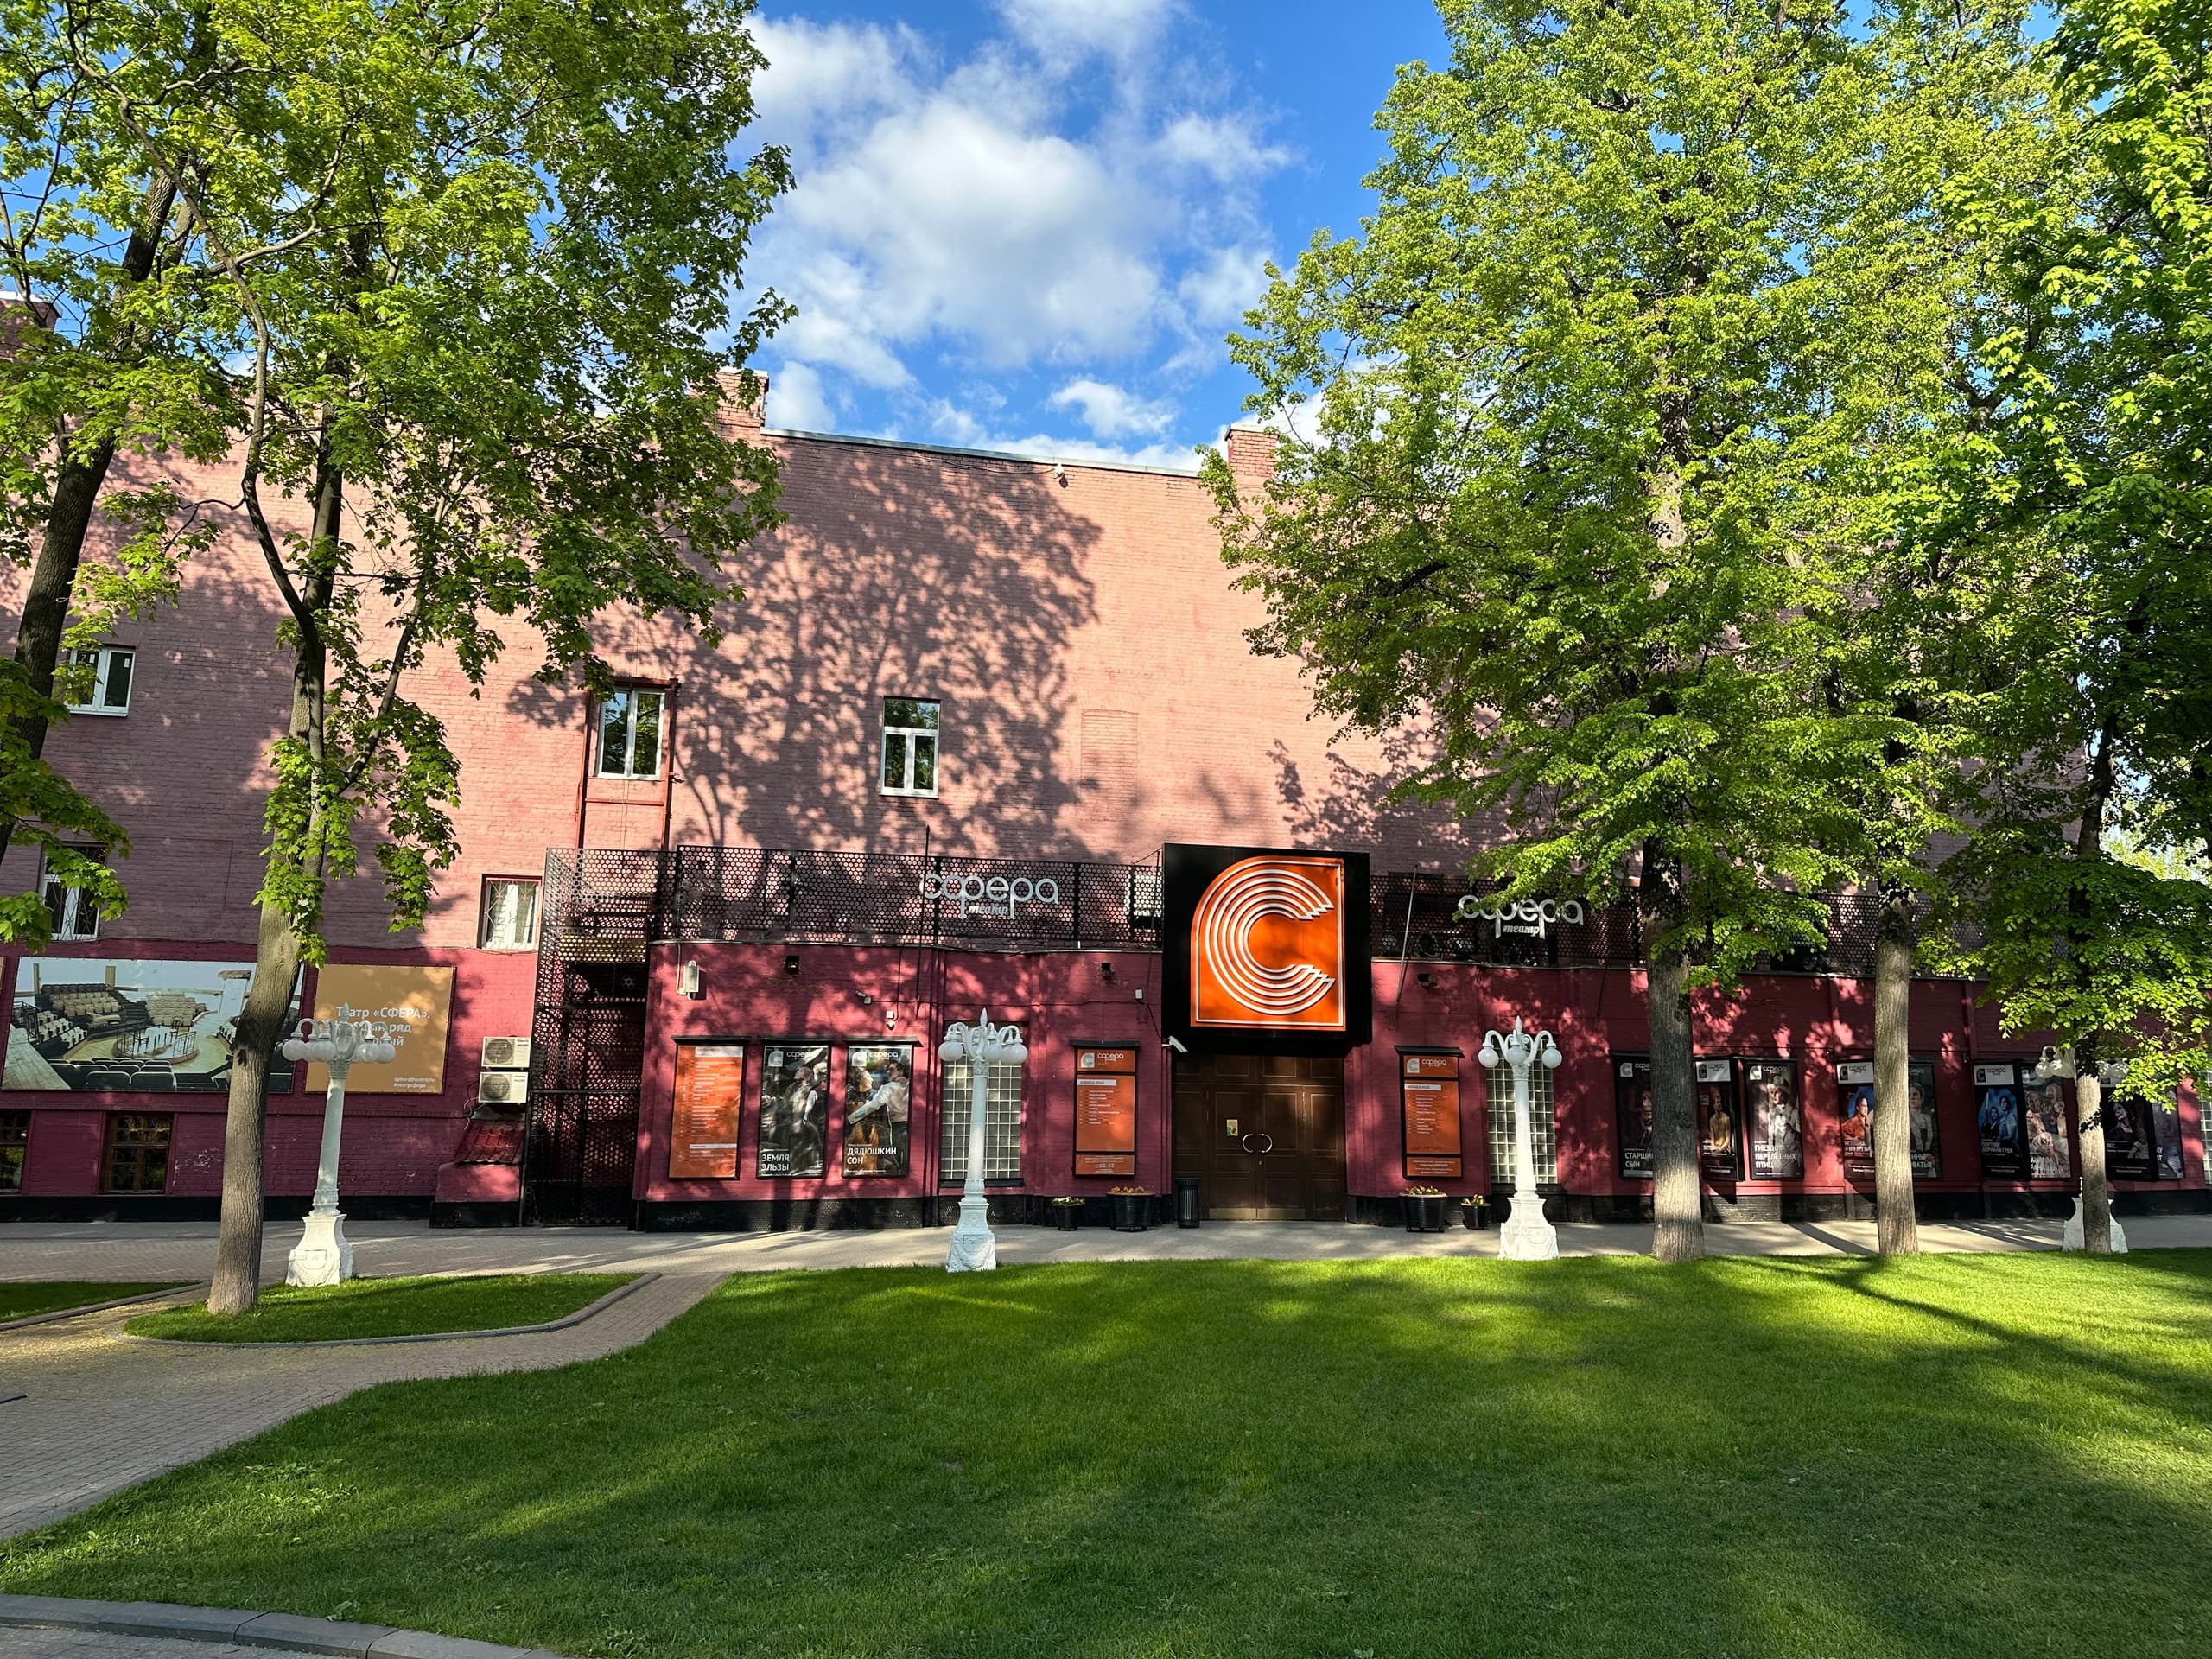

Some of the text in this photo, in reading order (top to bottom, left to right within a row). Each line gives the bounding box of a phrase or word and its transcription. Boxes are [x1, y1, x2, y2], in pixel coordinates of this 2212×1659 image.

[919, 873, 1059, 919] сфера
[336, 1007, 369, 1019] Татр
[389, 1024, 412, 1033] ряд
[848, 1147, 897, 1156] ДЯДЮШКИН
[761, 1154, 790, 1162] ЗЕМЛЯ
[848, 1156, 864, 1165] СОН
[761, 1163, 789, 1172] ЭЛЬЗЫ
